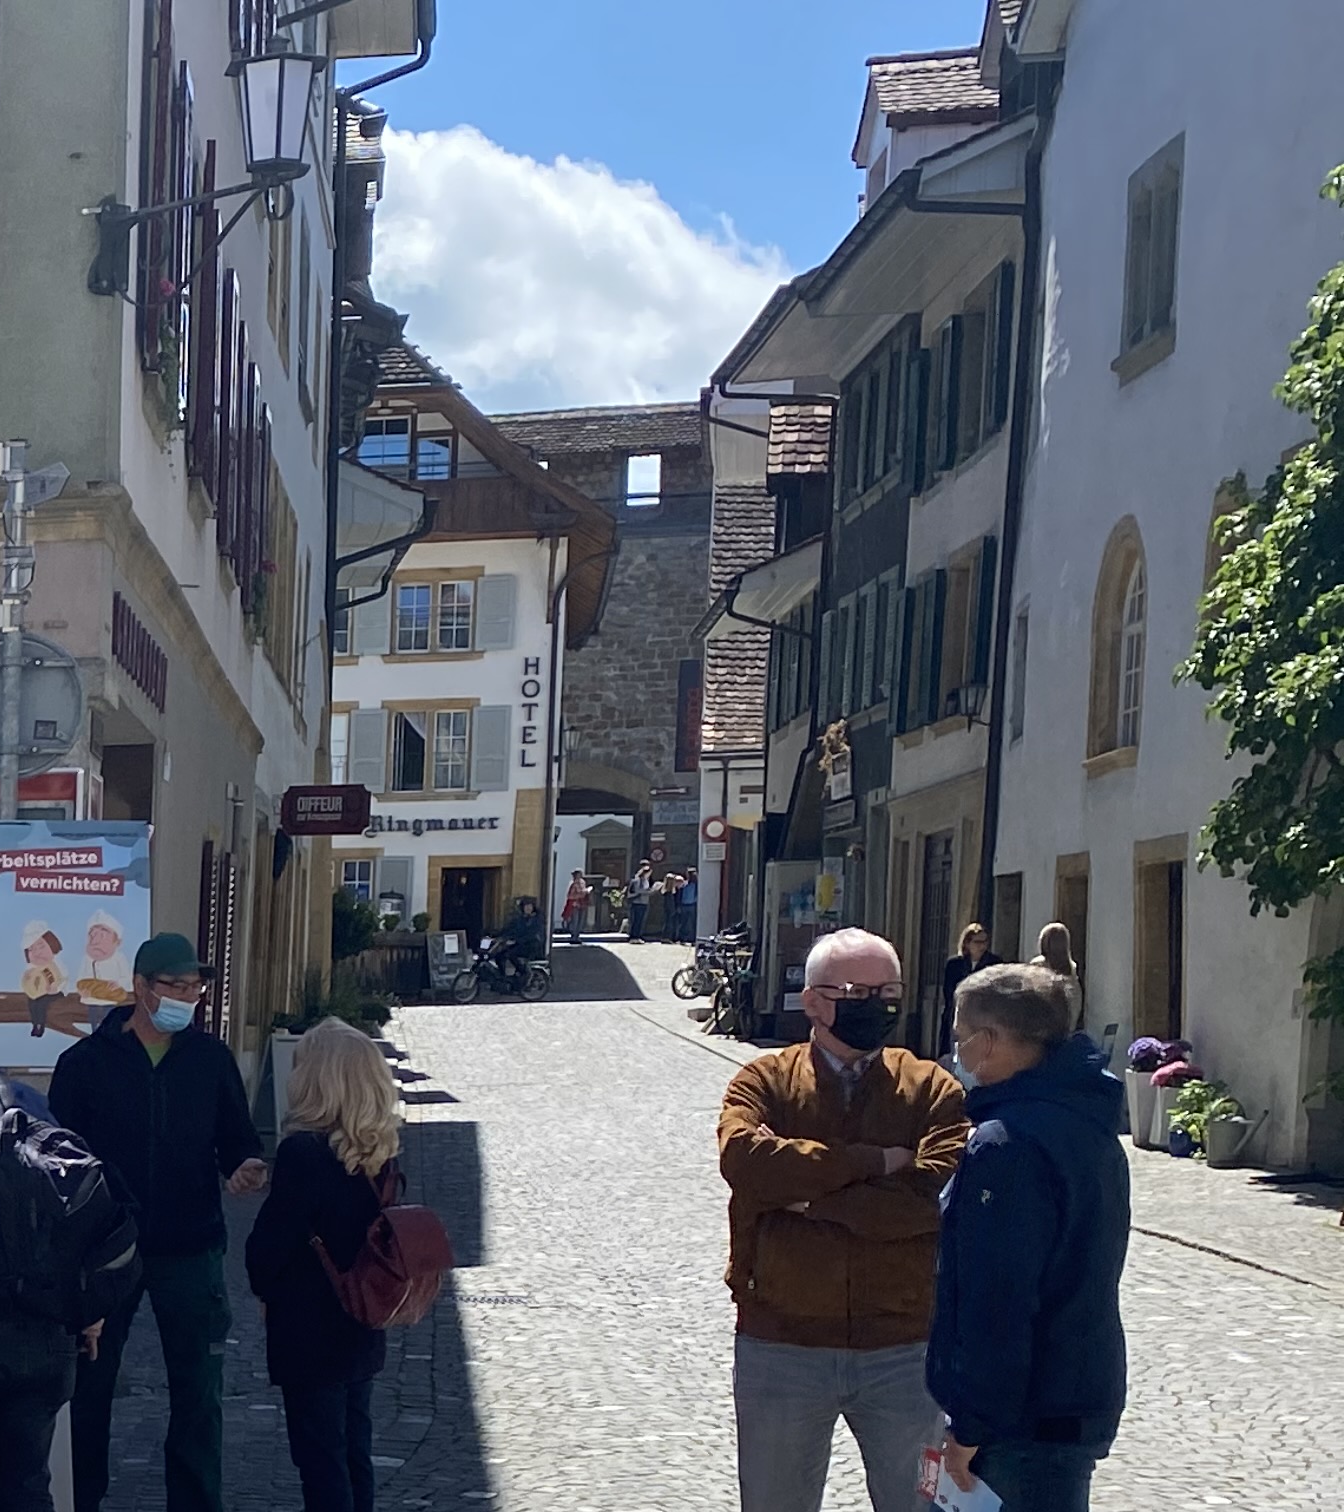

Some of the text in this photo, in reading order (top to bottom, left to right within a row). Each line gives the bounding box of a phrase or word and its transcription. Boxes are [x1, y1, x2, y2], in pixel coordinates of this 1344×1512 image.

[521, 657, 541, 768] HOTEL
[366, 815, 501, 837] Ringmauer
[19, 875, 120, 892] vernichten?
